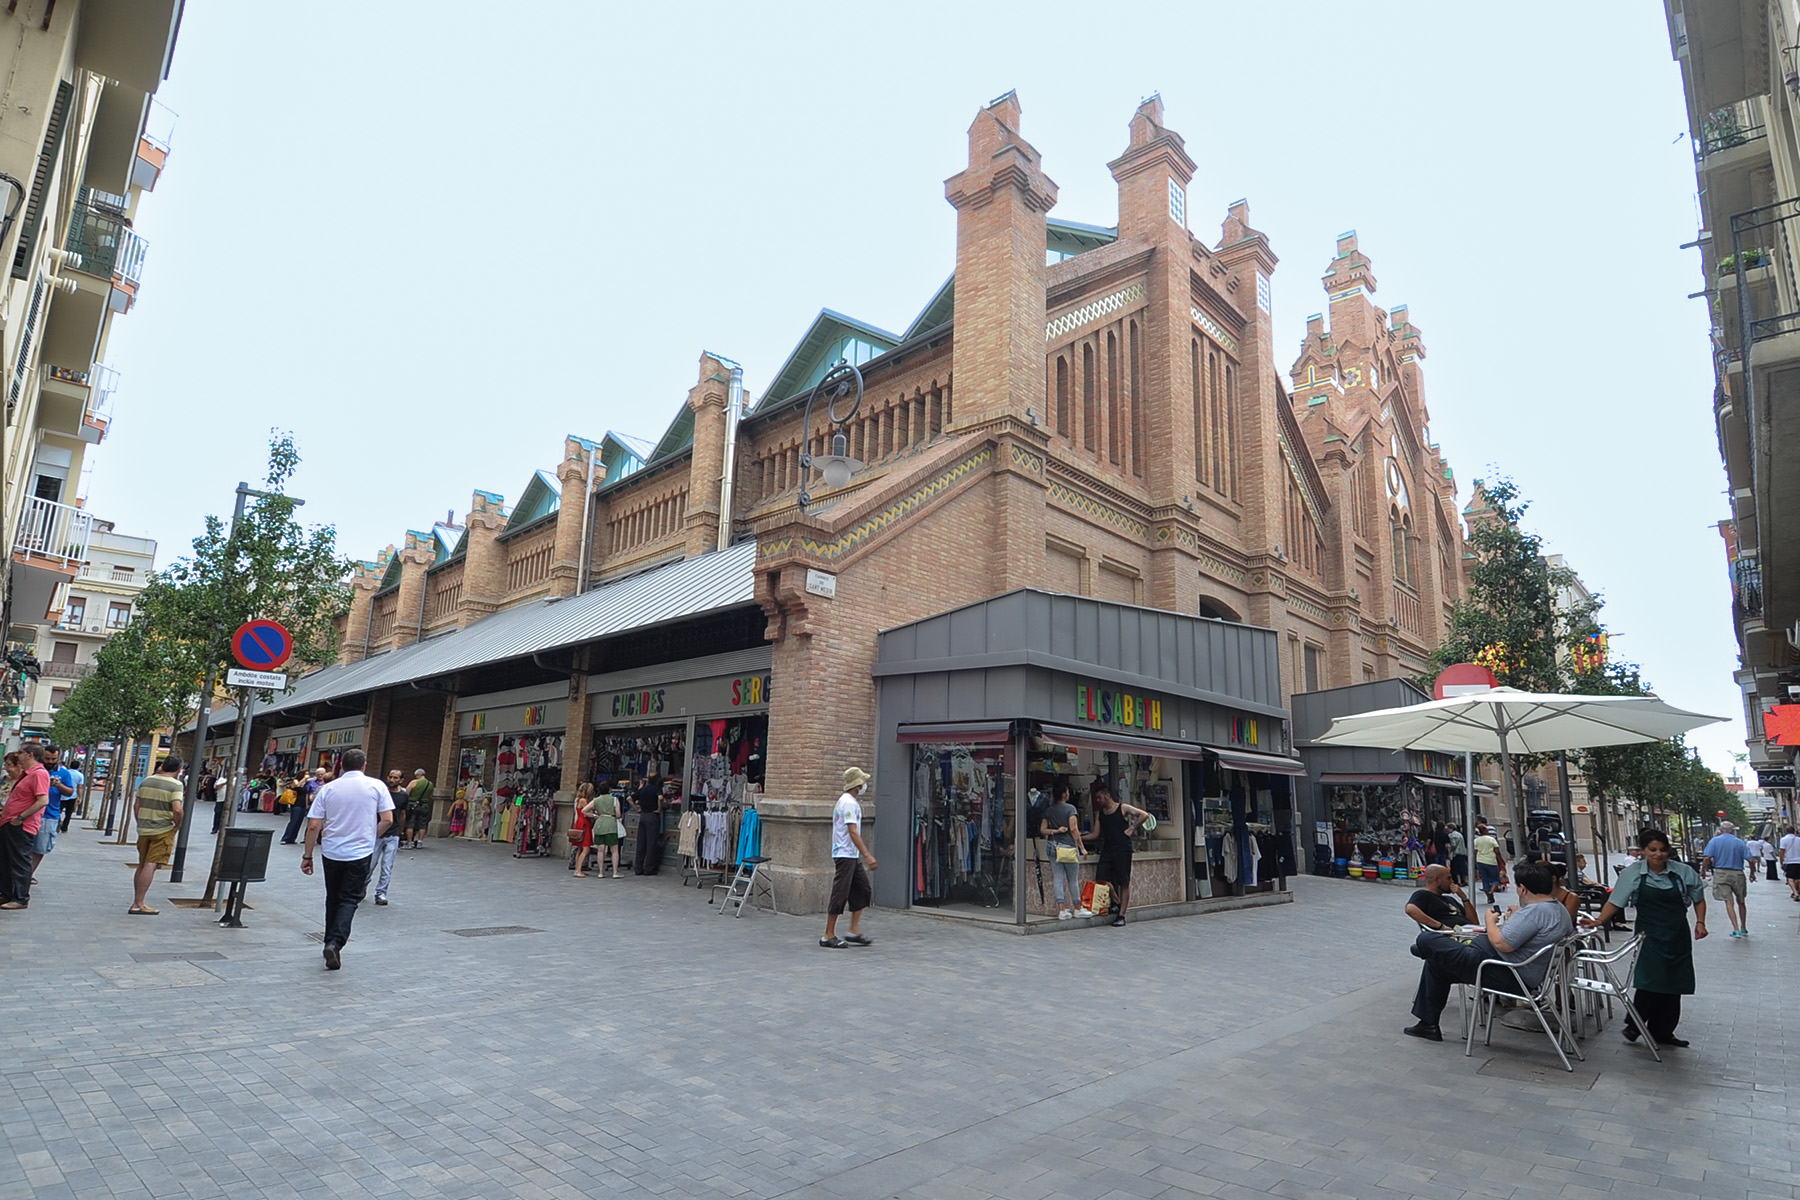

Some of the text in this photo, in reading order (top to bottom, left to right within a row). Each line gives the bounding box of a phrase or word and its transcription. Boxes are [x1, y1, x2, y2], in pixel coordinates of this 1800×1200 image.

[259, 673, 282, 681] costats
[611, 688, 666, 718] CUCADES
[1077, 685, 1161, 731] ELISABETH
[471, 712, 487, 732] ANA
[524, 704, 547, 727] ROSI
